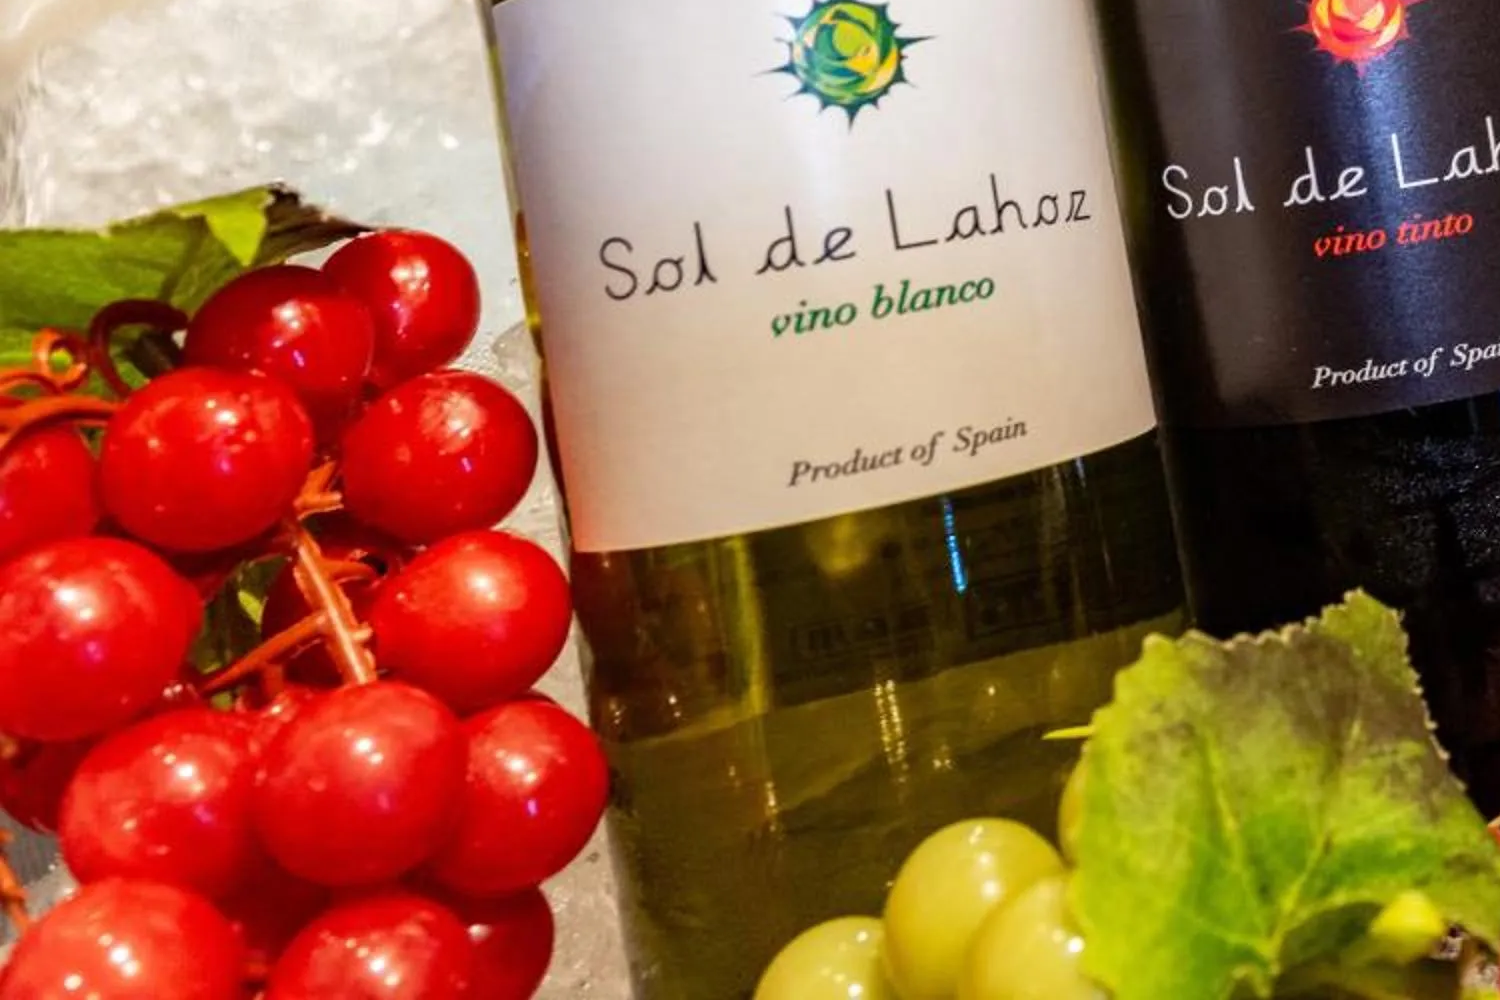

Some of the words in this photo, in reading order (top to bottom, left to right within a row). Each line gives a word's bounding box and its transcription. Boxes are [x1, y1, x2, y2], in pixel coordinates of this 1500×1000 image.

[1162, 156, 1254, 219] Sol
[1284, 146, 1367, 207] de
[599, 221, 717, 301] Sol
[755, 205, 856, 275] de
[886, 173, 1091, 251] Lahoz
[1313, 226, 1386, 258] vino
[1397, 213, 1473, 246] tinto
[770, 301, 857, 338] vino
[872, 276, 995, 318] blanco
[1312, 358, 1408, 389] Product
[1414, 348, 1443, 377] of
[788, 447, 905, 488] Product
[911, 430, 946, 466] of
[953, 418, 1027, 455] Spain
